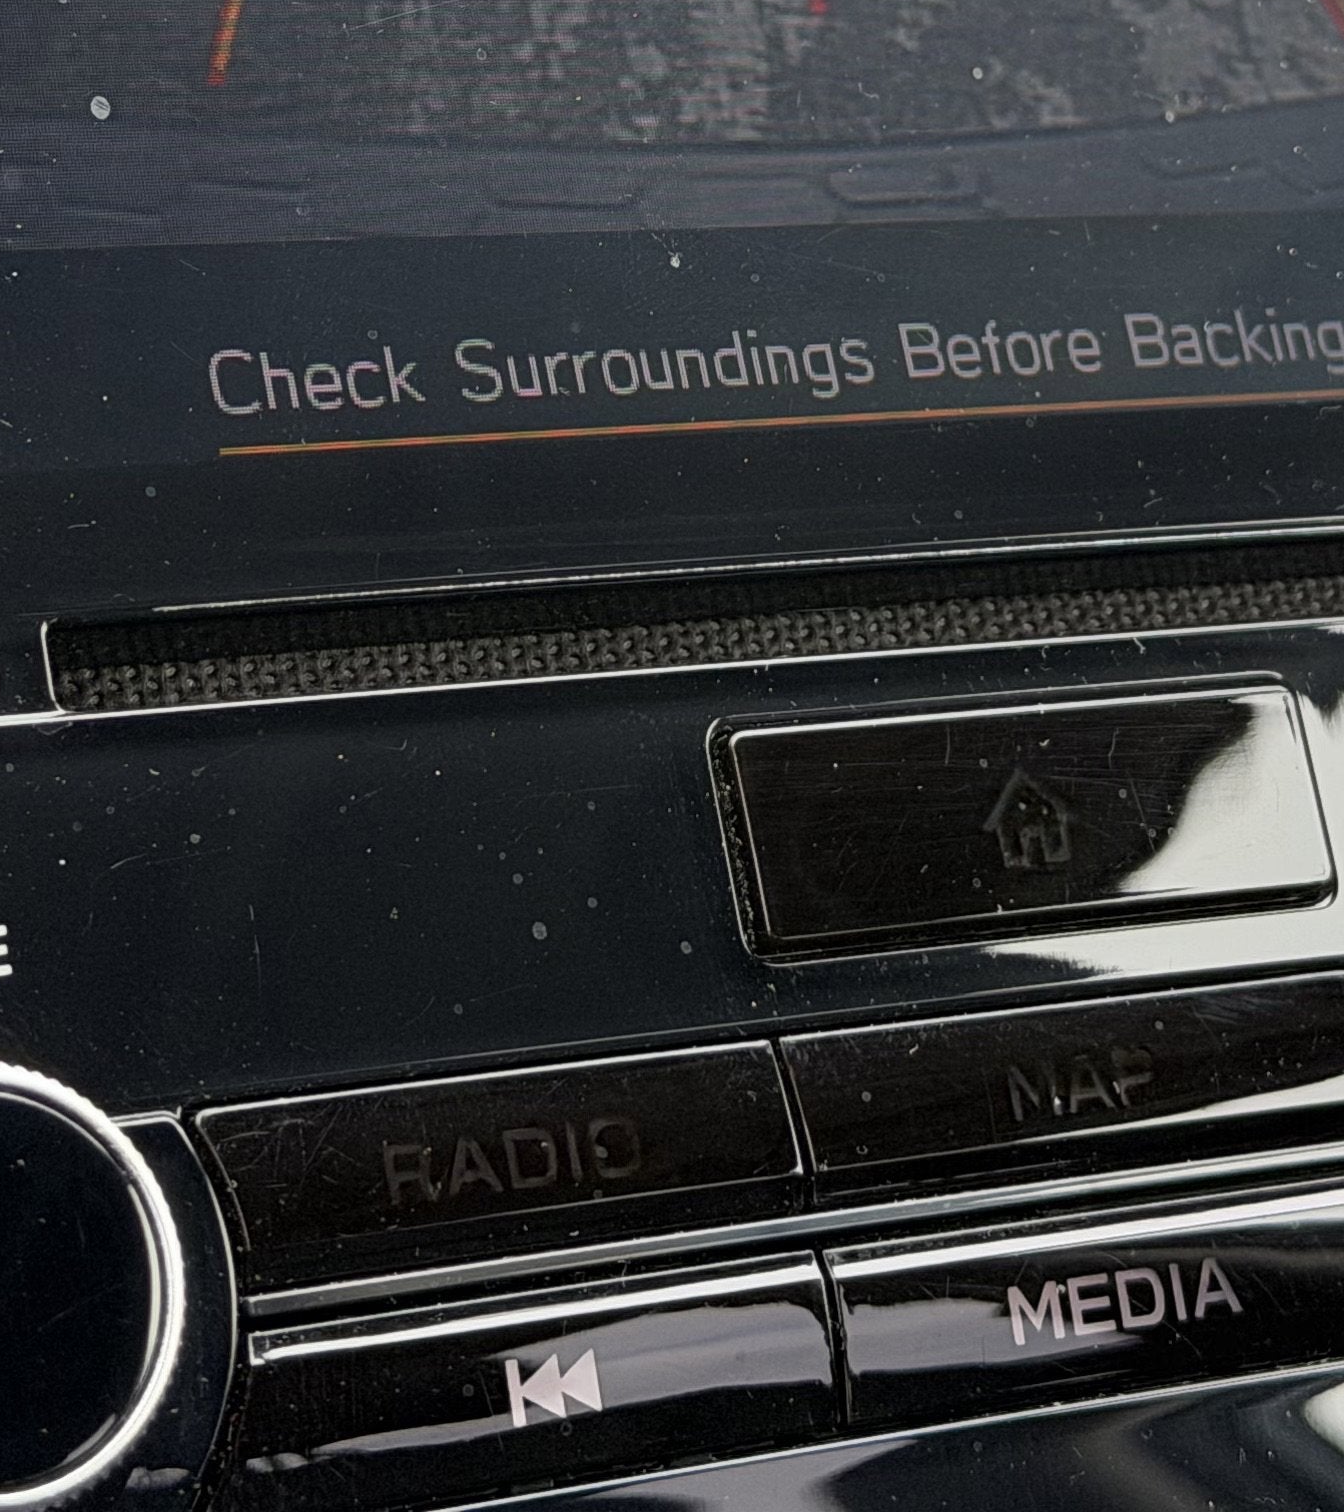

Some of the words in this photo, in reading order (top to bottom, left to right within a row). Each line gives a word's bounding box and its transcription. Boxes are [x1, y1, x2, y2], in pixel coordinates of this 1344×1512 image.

[208, 345, 426, 415] Check
[454, 328, 875, 400] Surroundings
[897, 319, 1102, 379] Before
[382, 1117, 641, 1205] RADIO
[1007, 1257, 1245, 1347] MEDIA
